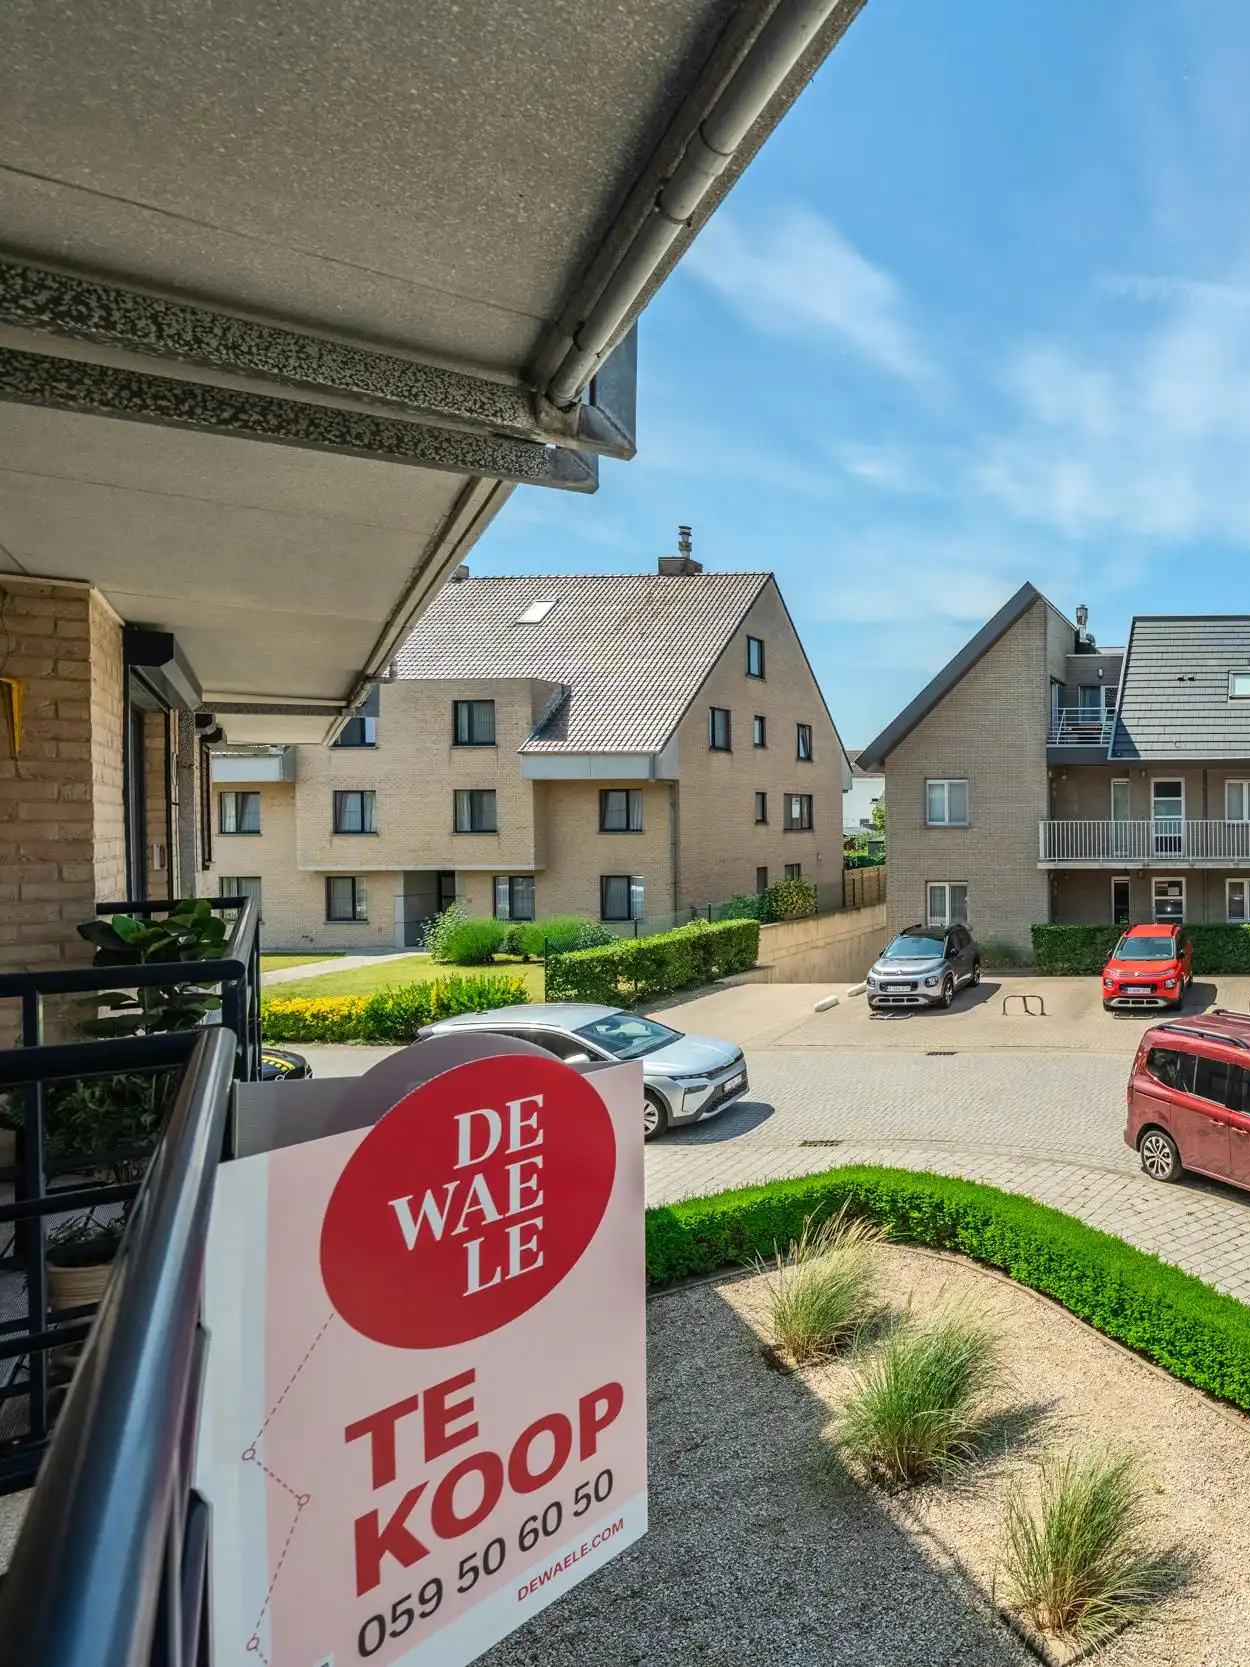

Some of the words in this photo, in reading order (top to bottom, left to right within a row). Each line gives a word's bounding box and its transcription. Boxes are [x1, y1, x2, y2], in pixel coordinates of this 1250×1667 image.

[452, 1093, 544, 1170] DE
[387, 1155, 544, 1251] WAE
[462, 1216, 544, 1297] LE
[344, 1367, 479, 1492] TE
[354, 1381, 624, 1597] KOOP
[357, 1577, 444, 1658] 059
[457, 1537, 506, 1594] 50
[518, 1501, 563, 1552] 60
[573, 1468, 614, 1518] 50
[517, 1518, 624, 1602] DEWAELE.COM
